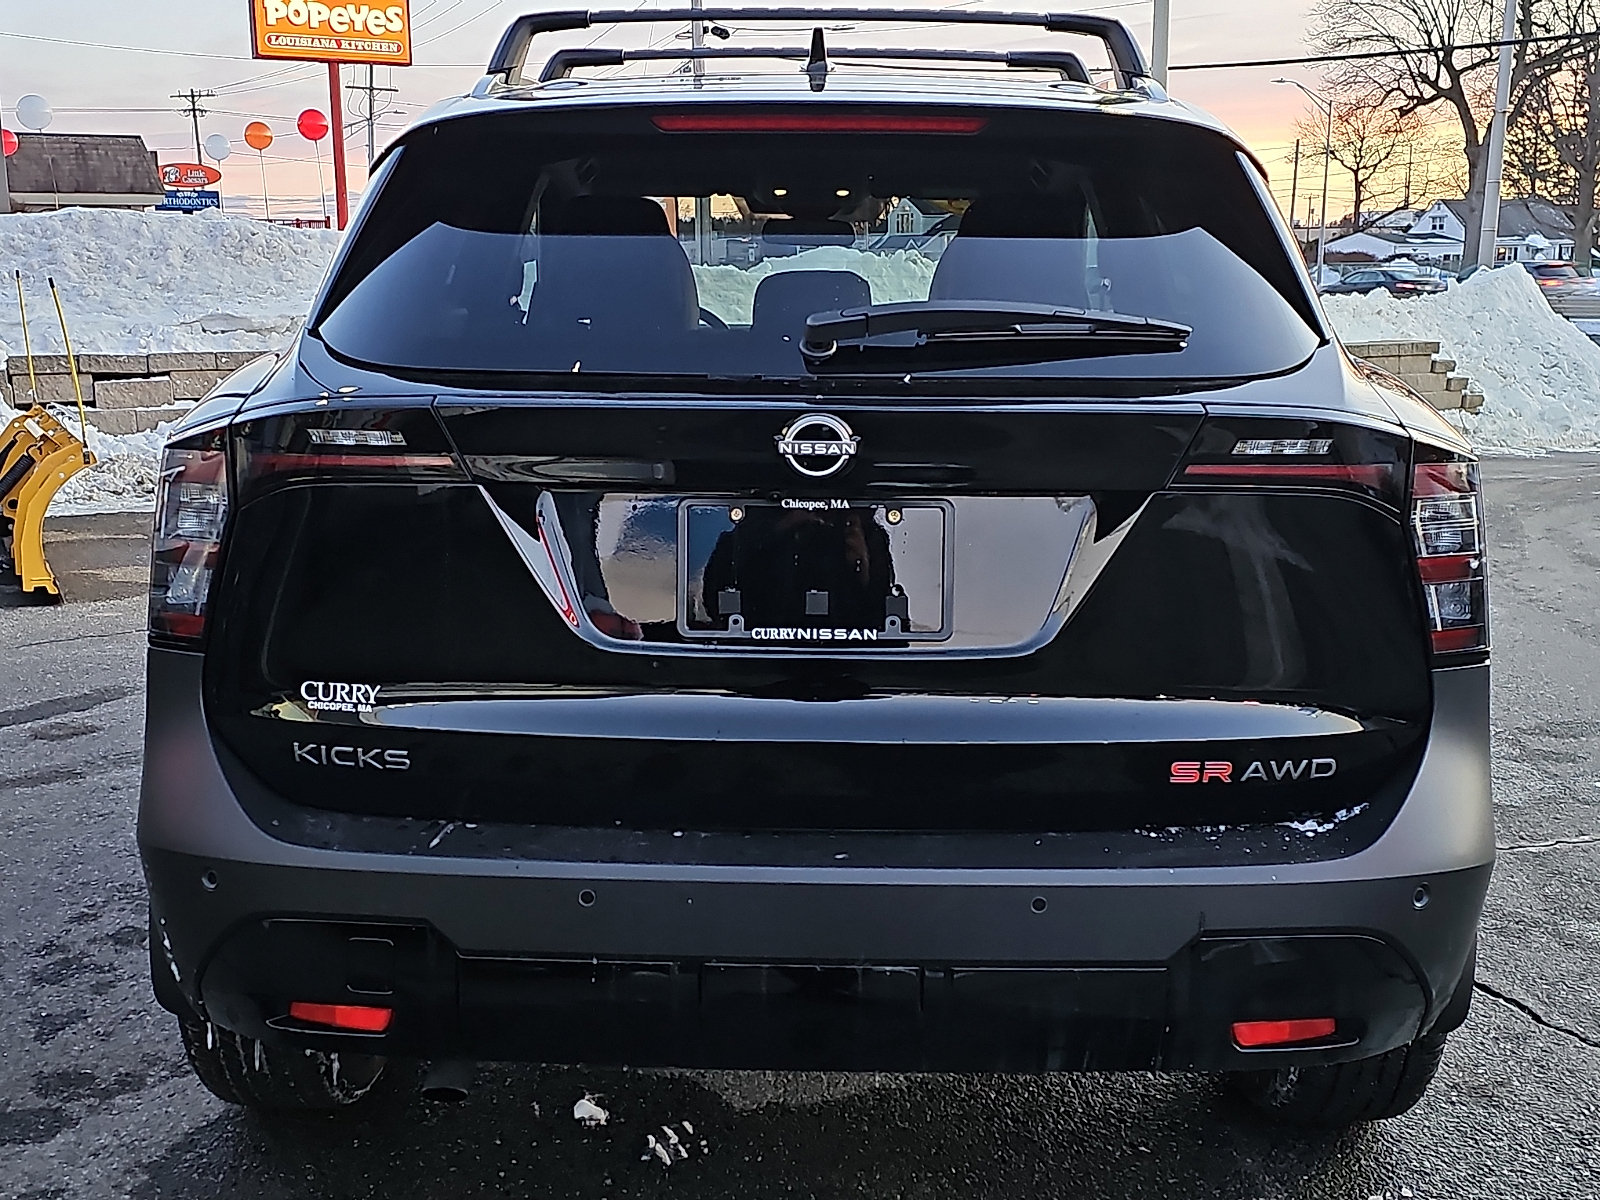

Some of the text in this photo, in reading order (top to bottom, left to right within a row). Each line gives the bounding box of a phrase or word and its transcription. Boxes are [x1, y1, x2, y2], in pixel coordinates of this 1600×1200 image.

[270, 35, 398, 52] LOUISIANA KITCHEN
[187, 169, 206, 178] Little
[163, 198, 218, 206] RTHODONTICS
[779, 443, 855, 454] NISSAN
[781, 499, 850, 510] Chicopee, MA
[300, 681, 381, 704] CURRY
[307, 701, 373, 713] CHICOPEE, MA
[293, 742, 410, 770] KICKS
[1169, 758, 1337, 783] SR AWD
